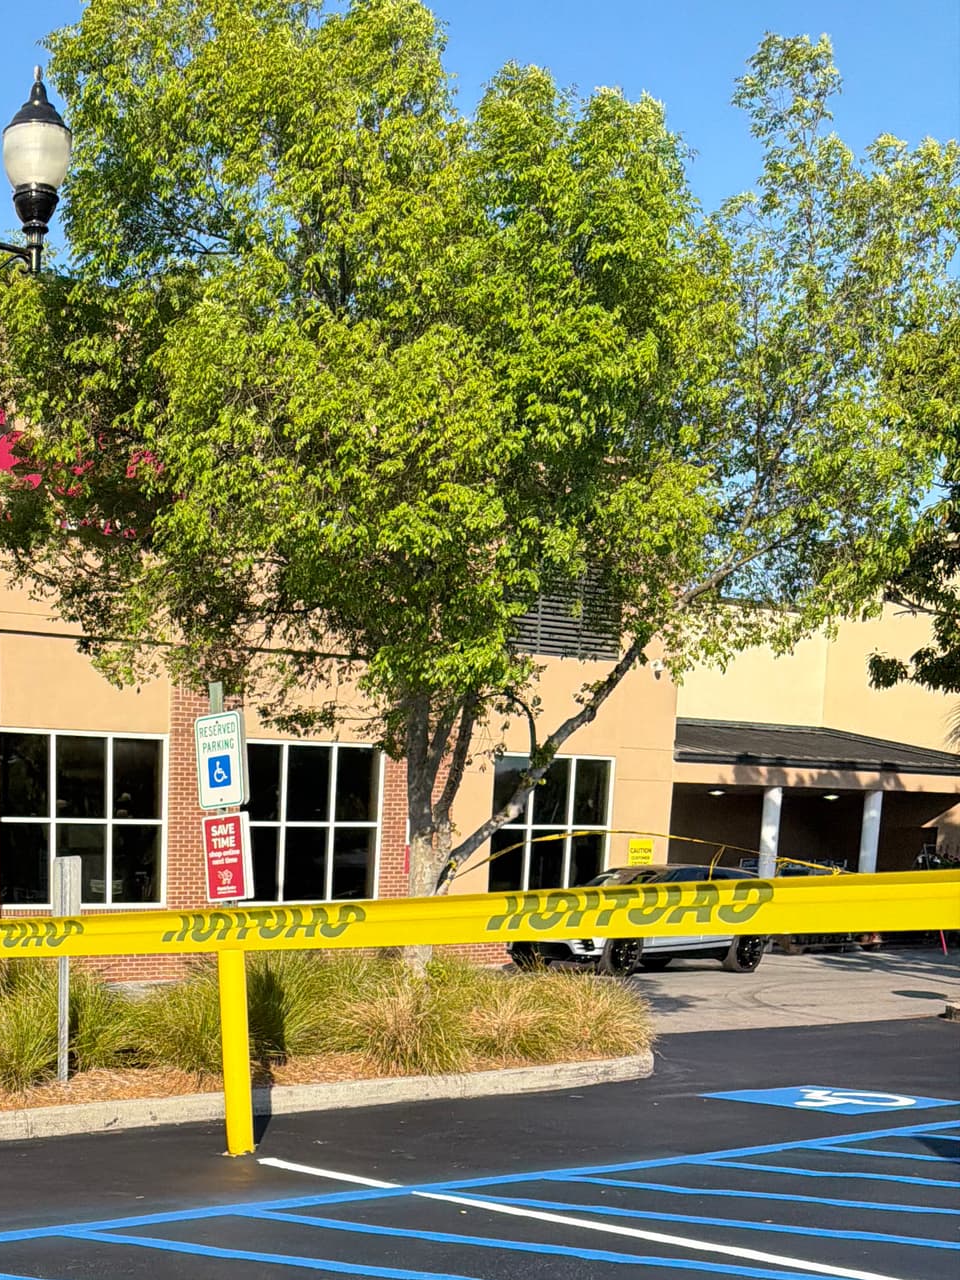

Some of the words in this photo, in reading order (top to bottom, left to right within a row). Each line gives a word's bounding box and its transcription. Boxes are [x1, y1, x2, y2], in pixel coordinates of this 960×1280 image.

[199, 722, 236, 738] RESERVED
[202, 738, 235, 753] PARKING
[211, 823, 236, 837] SAVE
[211, 836, 237, 849] TIME
